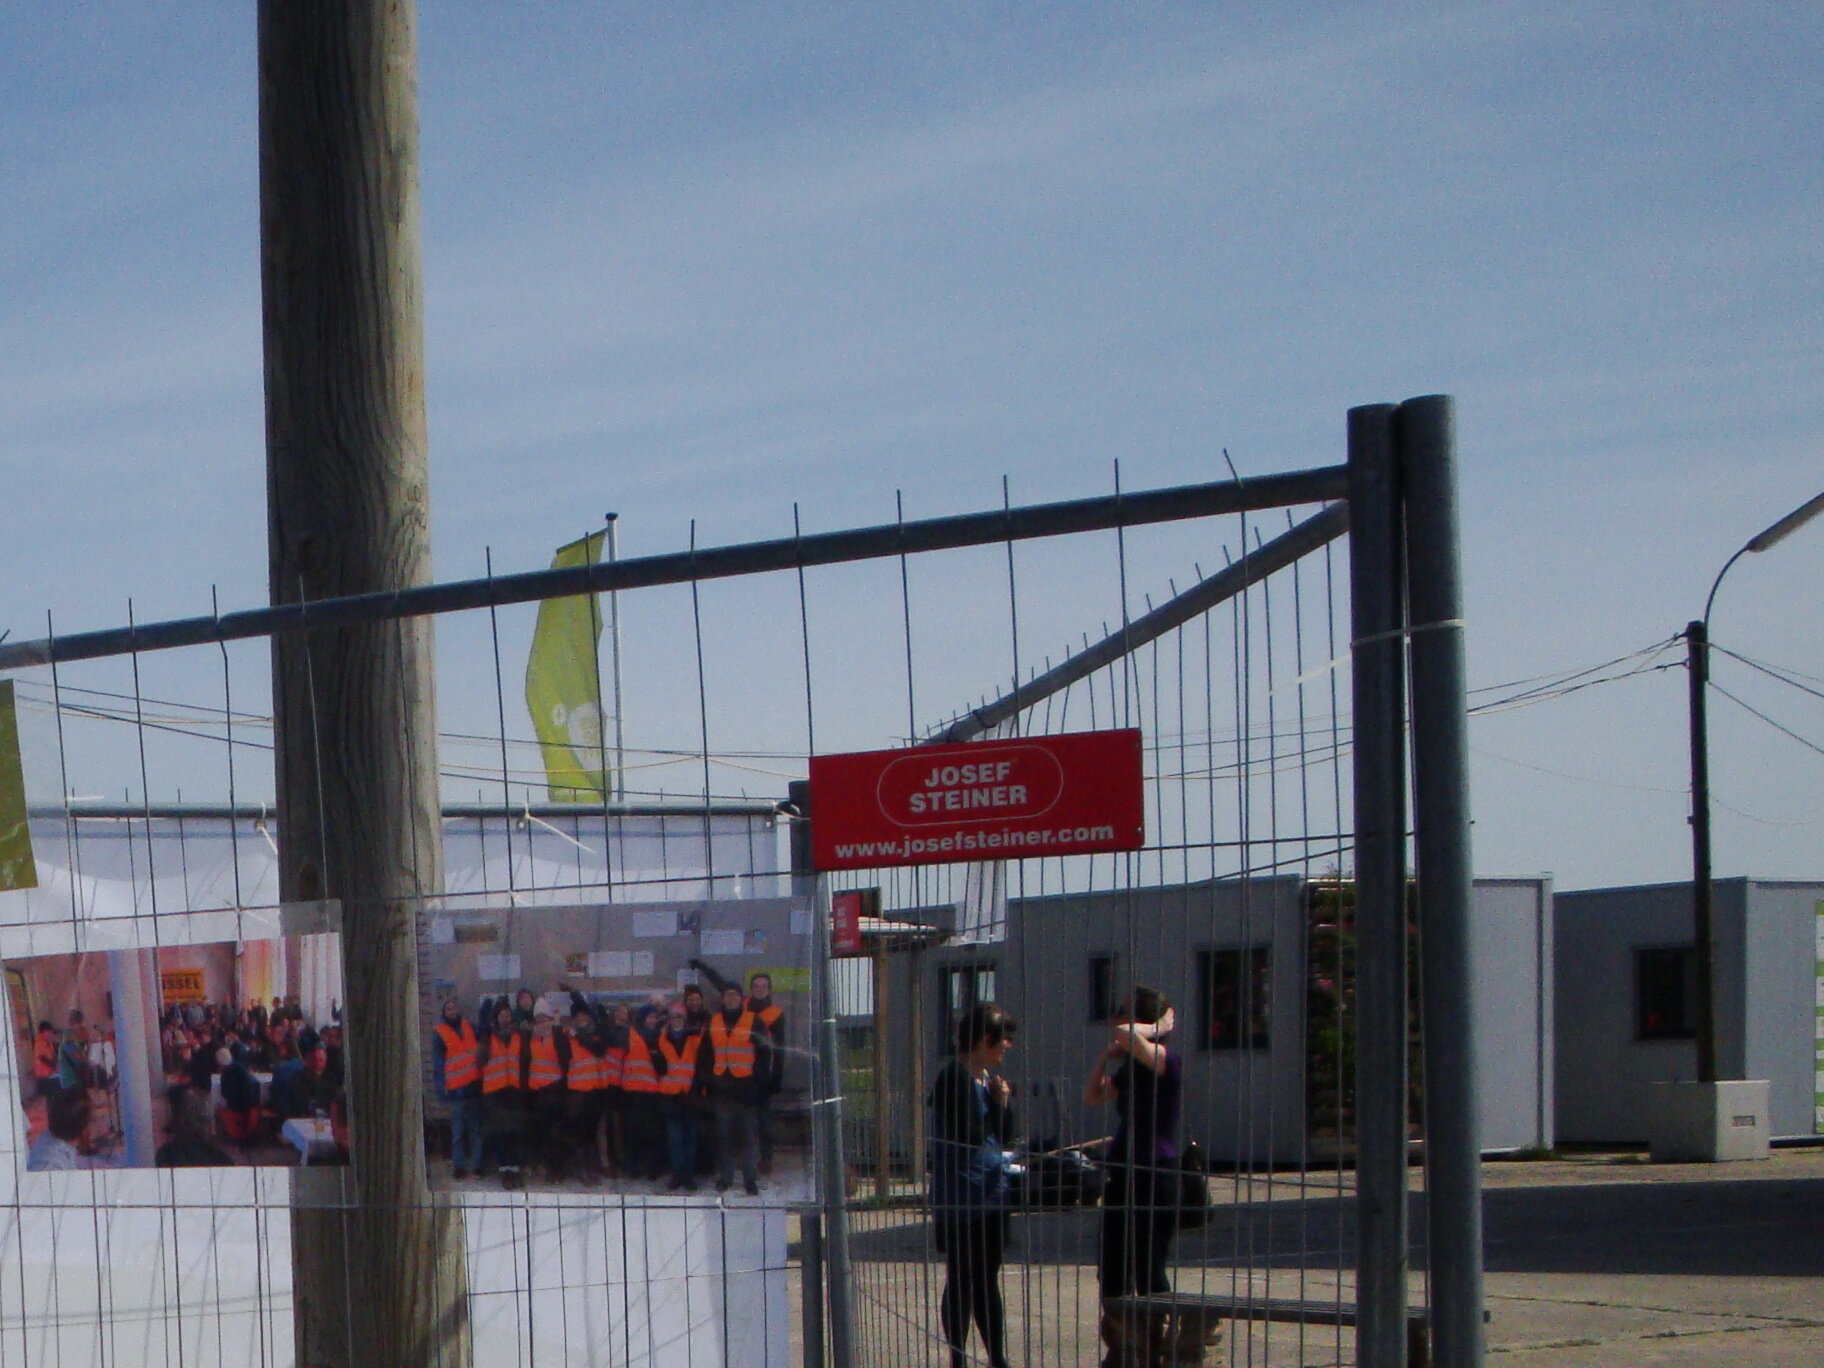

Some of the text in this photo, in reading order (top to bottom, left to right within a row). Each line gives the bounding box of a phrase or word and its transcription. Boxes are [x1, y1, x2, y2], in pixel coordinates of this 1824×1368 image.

[924, 762, 1011, 787] JOSEF
[909, 785, 1028, 813] STEINER
[835, 825, 1114, 859] www.josefsteiner.com
